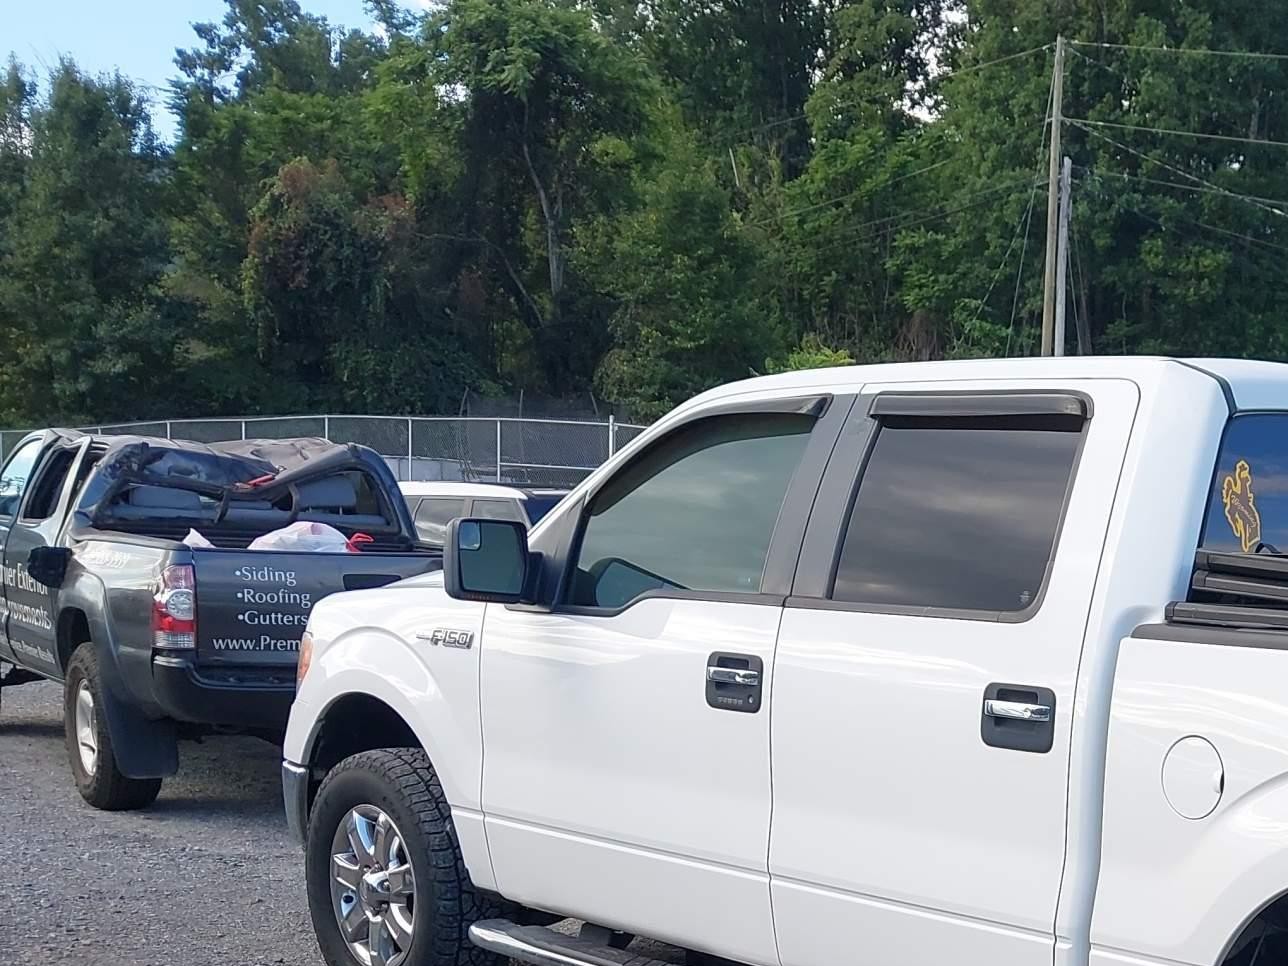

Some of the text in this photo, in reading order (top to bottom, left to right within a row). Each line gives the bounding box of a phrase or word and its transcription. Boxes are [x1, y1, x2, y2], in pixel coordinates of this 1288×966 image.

[241, 566, 297, 587] Siding
[243, 588, 312, 609] Roofing
[244, 610, 308, 625] Gutters
